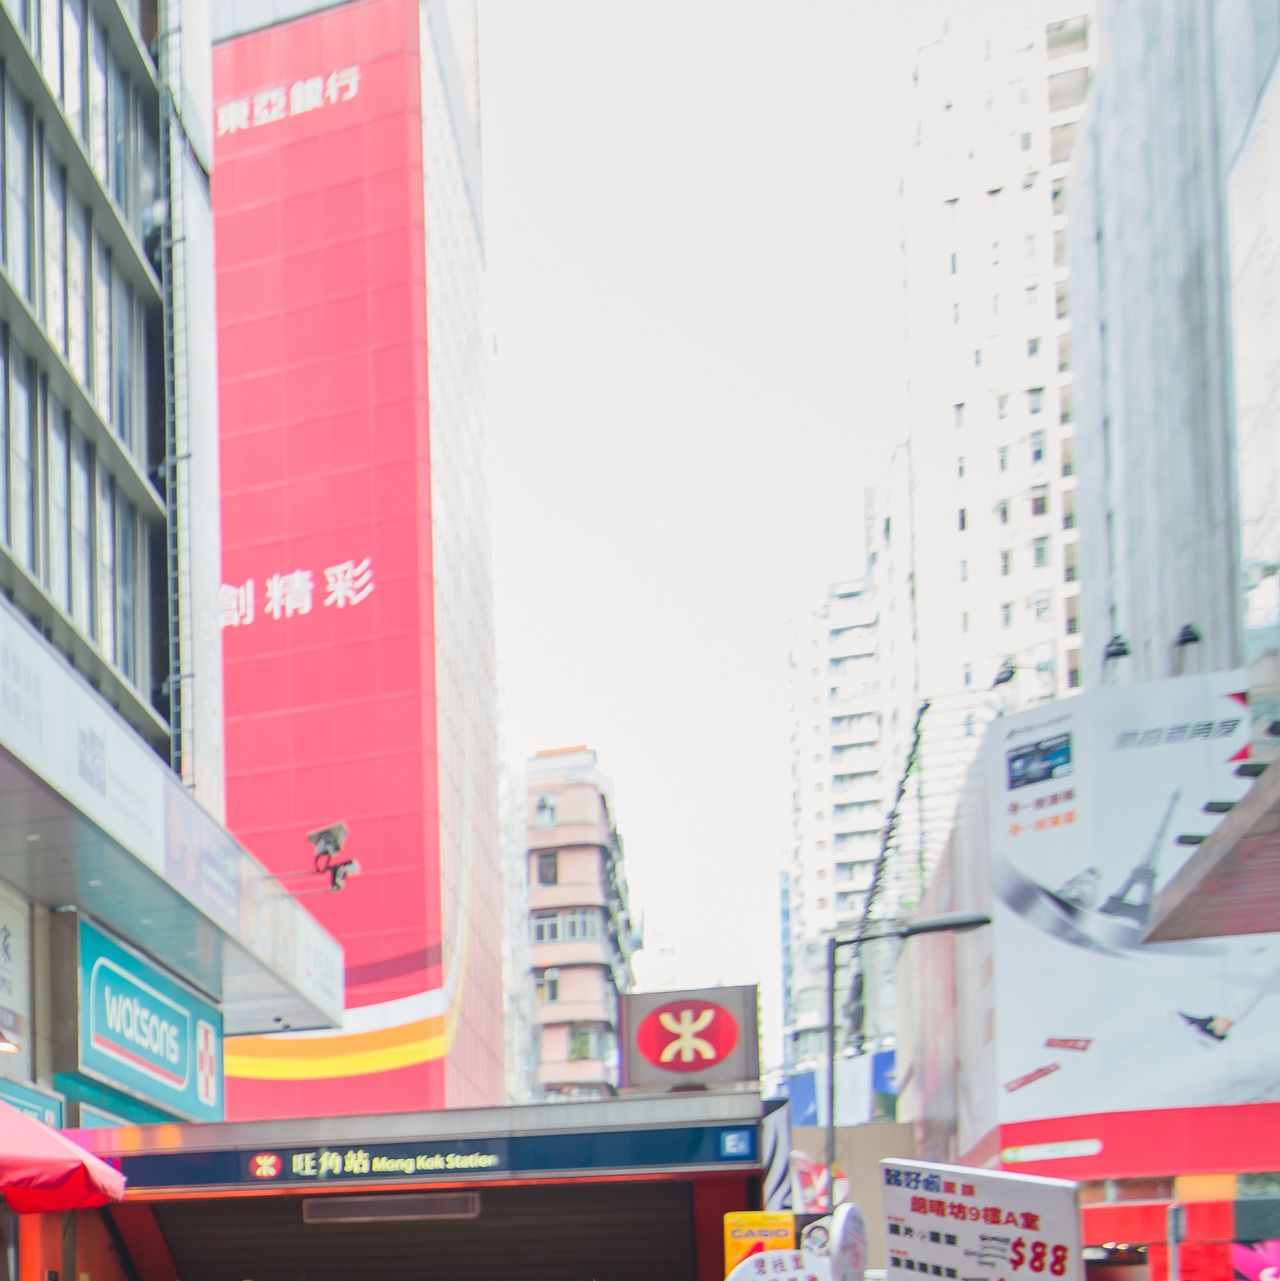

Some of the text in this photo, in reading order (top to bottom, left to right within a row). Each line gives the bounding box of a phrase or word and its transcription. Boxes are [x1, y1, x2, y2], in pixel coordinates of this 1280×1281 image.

[216, 66, 362, 137] 東亞銀行
[103, 984, 180, 1065] watsons
[291, 1149, 501, 1176] 旺角站 Mong Kok Station
[731, 1228, 789, 1239] CASIO
[1009, 1236, 1069, 1278] $88
